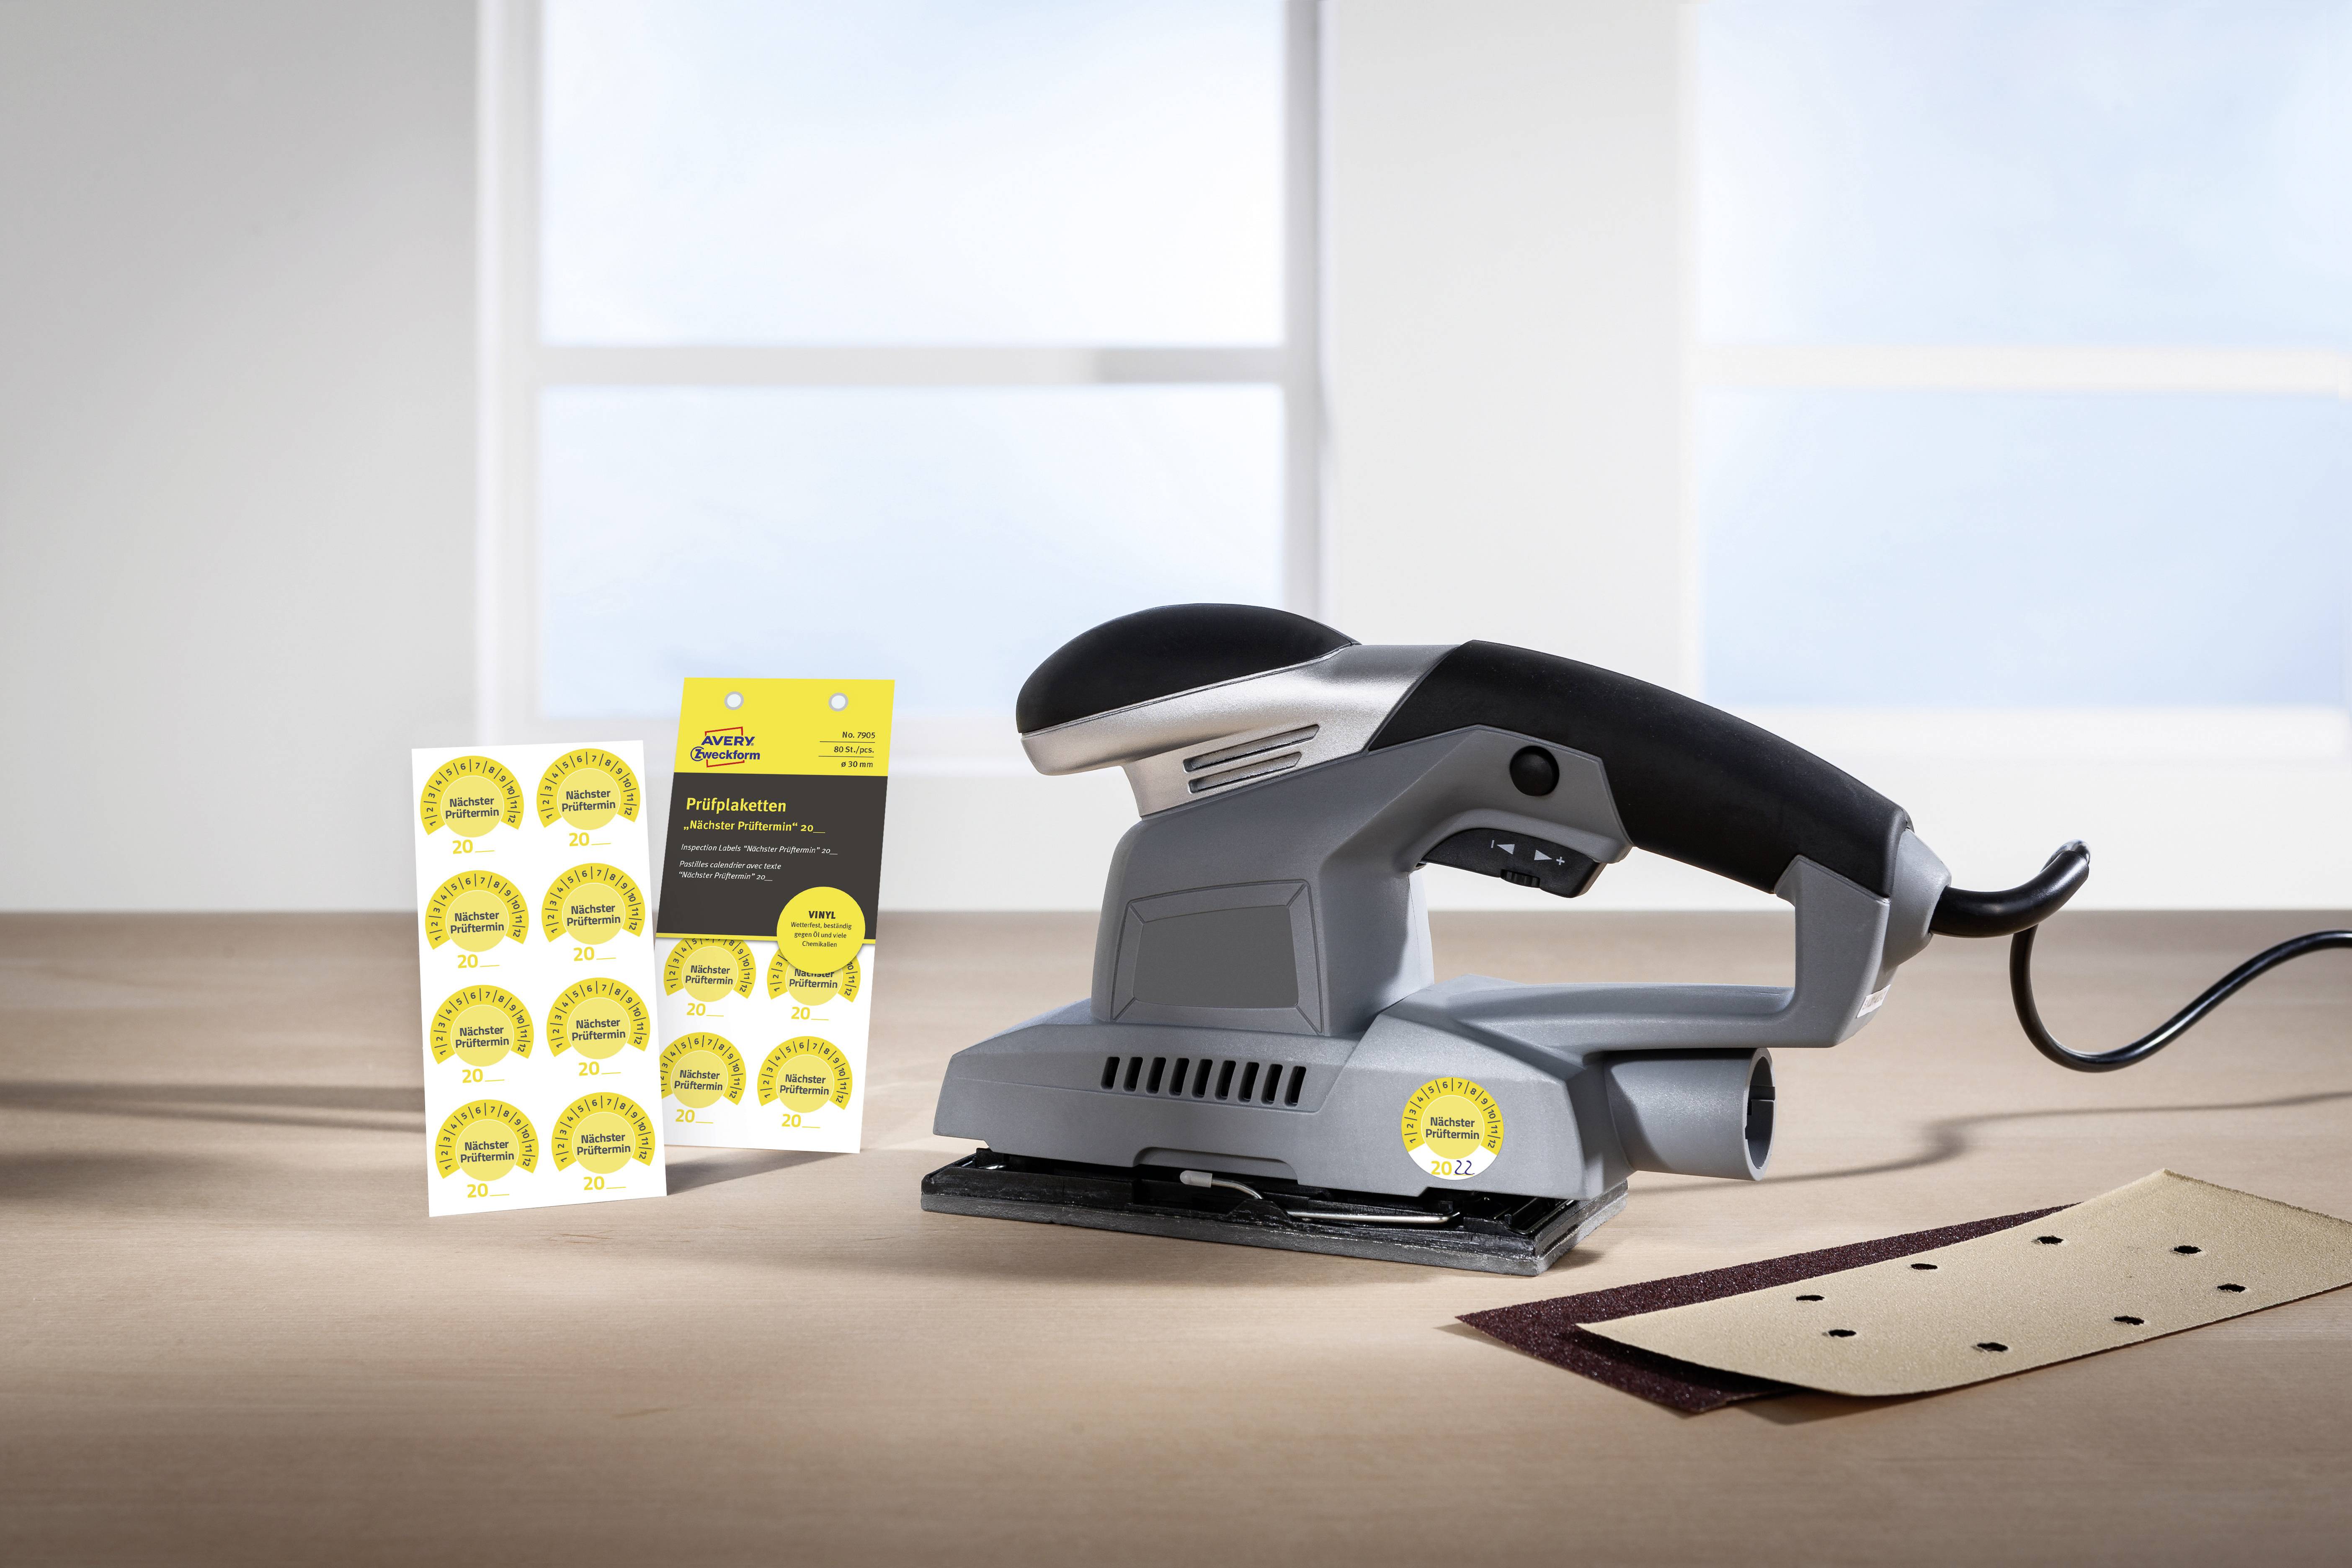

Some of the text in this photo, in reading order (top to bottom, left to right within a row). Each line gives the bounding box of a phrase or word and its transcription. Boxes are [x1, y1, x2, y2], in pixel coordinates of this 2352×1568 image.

[690, 746, 760, 761] Zweckform
[846, 746, 874, 754] St./pcs.
[507, 785, 515, 795] 10
[566, 790, 610, 799] Nächster
[450, 797, 494, 807] Nächster
[510, 800, 517, 809] 11
[562, 800, 615, 812] Prüftermin
[686, 797, 786, 814] Prüfplaketten
[446, 807, 499, 819] Prüftermin
[508, 815, 516, 823] 12
[571, 905, 615, 914] Nächster
[455, 912, 499, 921] Nächster
[808, 910, 836, 919] VINYL
[567, 915, 620, 926] Prüftermin
[451, 922, 504, 934] Prüftermin
[742, 958, 750, 967] 10
[691, 965, 730, 974] Nächster
[686, 975, 732, 984] Prüftermin
[789, 979, 837, 988] Prüftermin
[576, 1019, 620, 1029] Nächster
[460, 1026, 504, 1036] Nächster
[572, 1029, 625, 1041] Prüftermin
[456, 1037, 509, 1048] Prüftermin
[732, 1063, 740, 1072] 10
[838, 1068, 846, 1076] 10
[680, 1070, 720, 1079] Nächster
[786, 1074, 826, 1083] Nächster
[674, 1081, 722, 1090] Prüftermin
[780, 1085, 829, 1095] Prüftermin
[729, 1090, 738, 1099] 12
[1488, 1109, 1496, 1119] 10
[638, 1122, 646, 1131] 10
[1431, 1117, 1475, 1127] Nächster
[1491, 1125, 1498, 1133] 11
[581, 1134, 625, 1143] Nächster
[1426, 1129, 1479, 1139] Prüftermin
[465, 1141, 509, 1150] Nächster
[641, 1137, 649, 1145] 11
[1488, 1140, 1496, 1148] 12
[577, 1144, 630, 1155] Prüftermin
[461, 1151, 514, 1163] Prüftermin
[639, 1151, 647, 1159] 12
